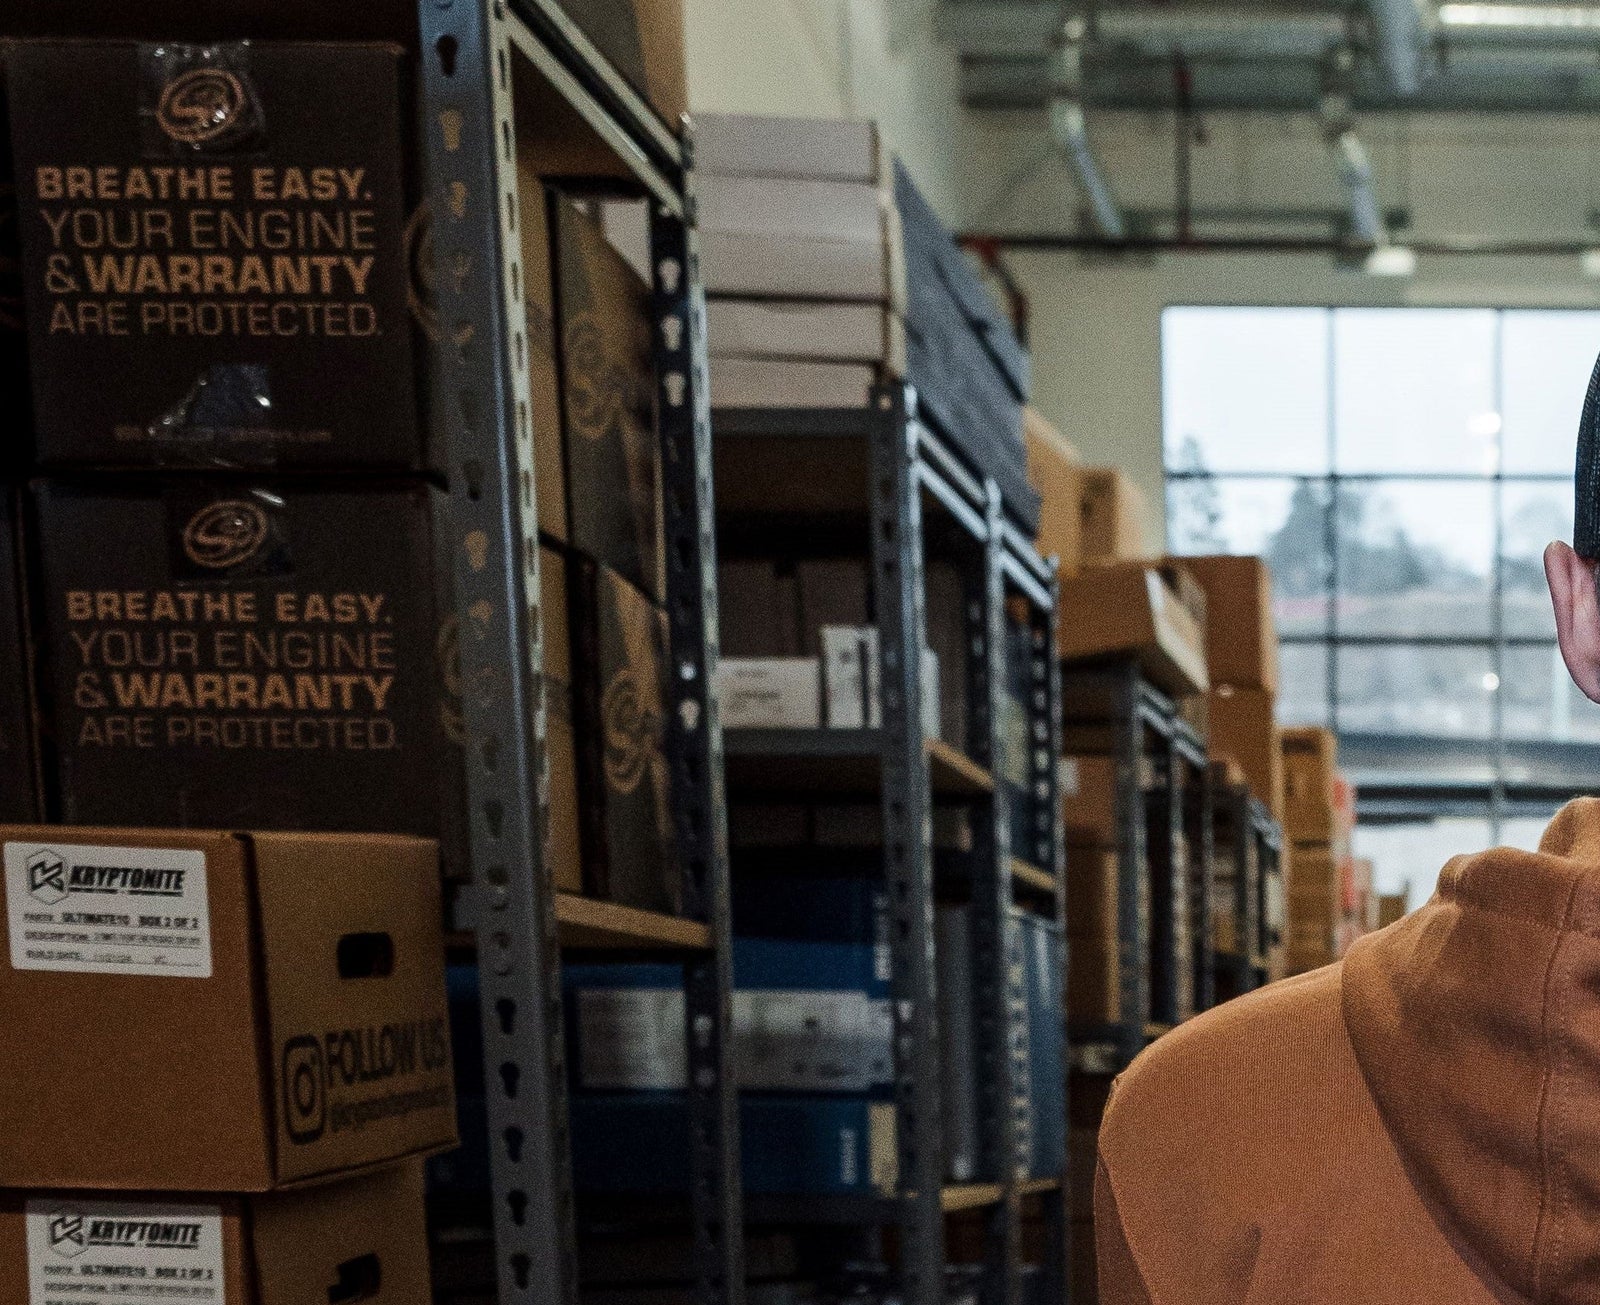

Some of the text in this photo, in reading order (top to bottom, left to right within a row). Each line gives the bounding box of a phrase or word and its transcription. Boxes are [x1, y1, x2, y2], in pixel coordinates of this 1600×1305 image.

[35, 166, 373, 200] BREATHE EASY.
[39, 208, 377, 249] YOUR ENGINE
[50, 302, 130, 337] ARE
[66, 590, 394, 624] BREATHE EASY.
[71, 629, 397, 669] YOUR ENGINE
[78, 716, 153, 748] ARE
[69, 865, 185, 890] KRYPTONITE
[325, 1016, 448, 1088] FOLLOW US
[89, 1220, 201, 1244] KRYPTONITE
